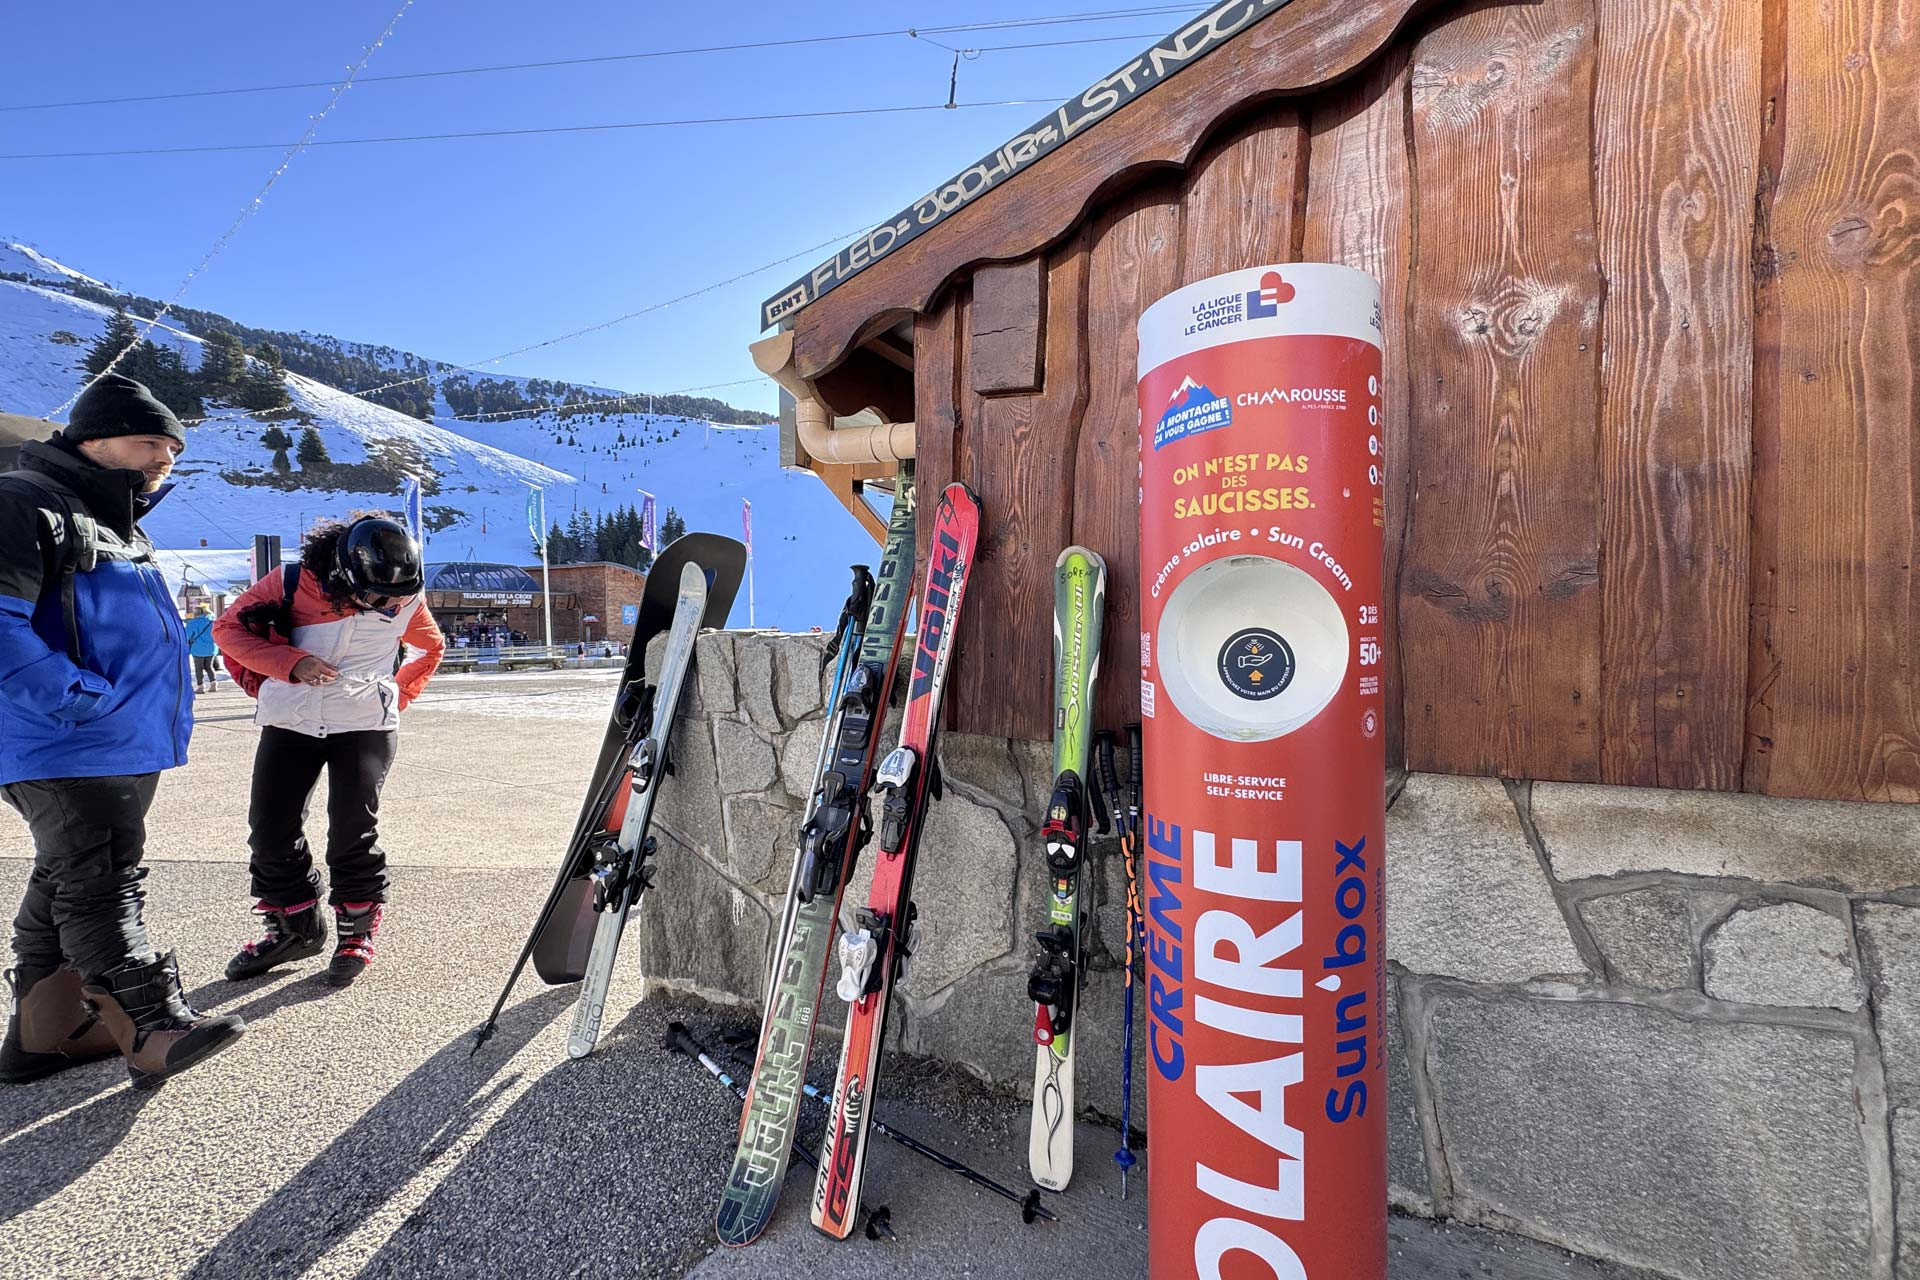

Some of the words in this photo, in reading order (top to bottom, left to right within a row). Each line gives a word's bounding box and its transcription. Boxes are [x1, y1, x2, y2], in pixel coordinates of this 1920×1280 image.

[769, 290, 804, 319] BNT
[1192, 302, 1206, 314] LA
[1208, 293, 1243, 308] LIGUE
[1196, 304, 1242, 322] CONTRE
[1184, 325, 1196, 336] LE
[1197, 313, 1242, 332] CANCER
[1236, 387, 1347, 406] CHAMROUSSE
[1156, 420, 1166, 434] LA
[1167, 397, 1229, 428] MONTAGNE
[1164, 423, 1185, 440] VOUS
[1187, 411, 1222, 430] GAGNE
[1173, 463, 1199, 484] ON
[1205, 454, 1260, 478] N'EST
[1266, 455, 1309, 473] PAS
[1222, 475, 1247, 489] DES
[1173, 487, 1316, 520] SAUCISSES.
[1061, 566, 1093, 584] SOREN
[1151, 554, 1181, 599] Crème
[1183, 527, 1242, 558] solaire
[1267, 526, 1304, 550] Sun
[1308, 541, 1354, 592] Cream
[1358, 605, 1368, 625] 3
[1070, 581, 1085, 702] ROSSIGNOL
[1359, 643, 1382, 666] 50+
[1239, 688, 1256, 697] VOTRE
[1203, 773, 1286, 788] LIBRE-SERVICE
[1206, 785, 1284, 801] SELF-SERVICE
[1147, 813, 1185, 1082] CRÈME
[572, 992, 589, 1037] WHISPER
[584, 1003, 603, 1044] PRO
[801, 1006, 811, 1025] 168
[815, 1114, 838, 1213] RACING
[827, 1131, 856, 1226] GS
